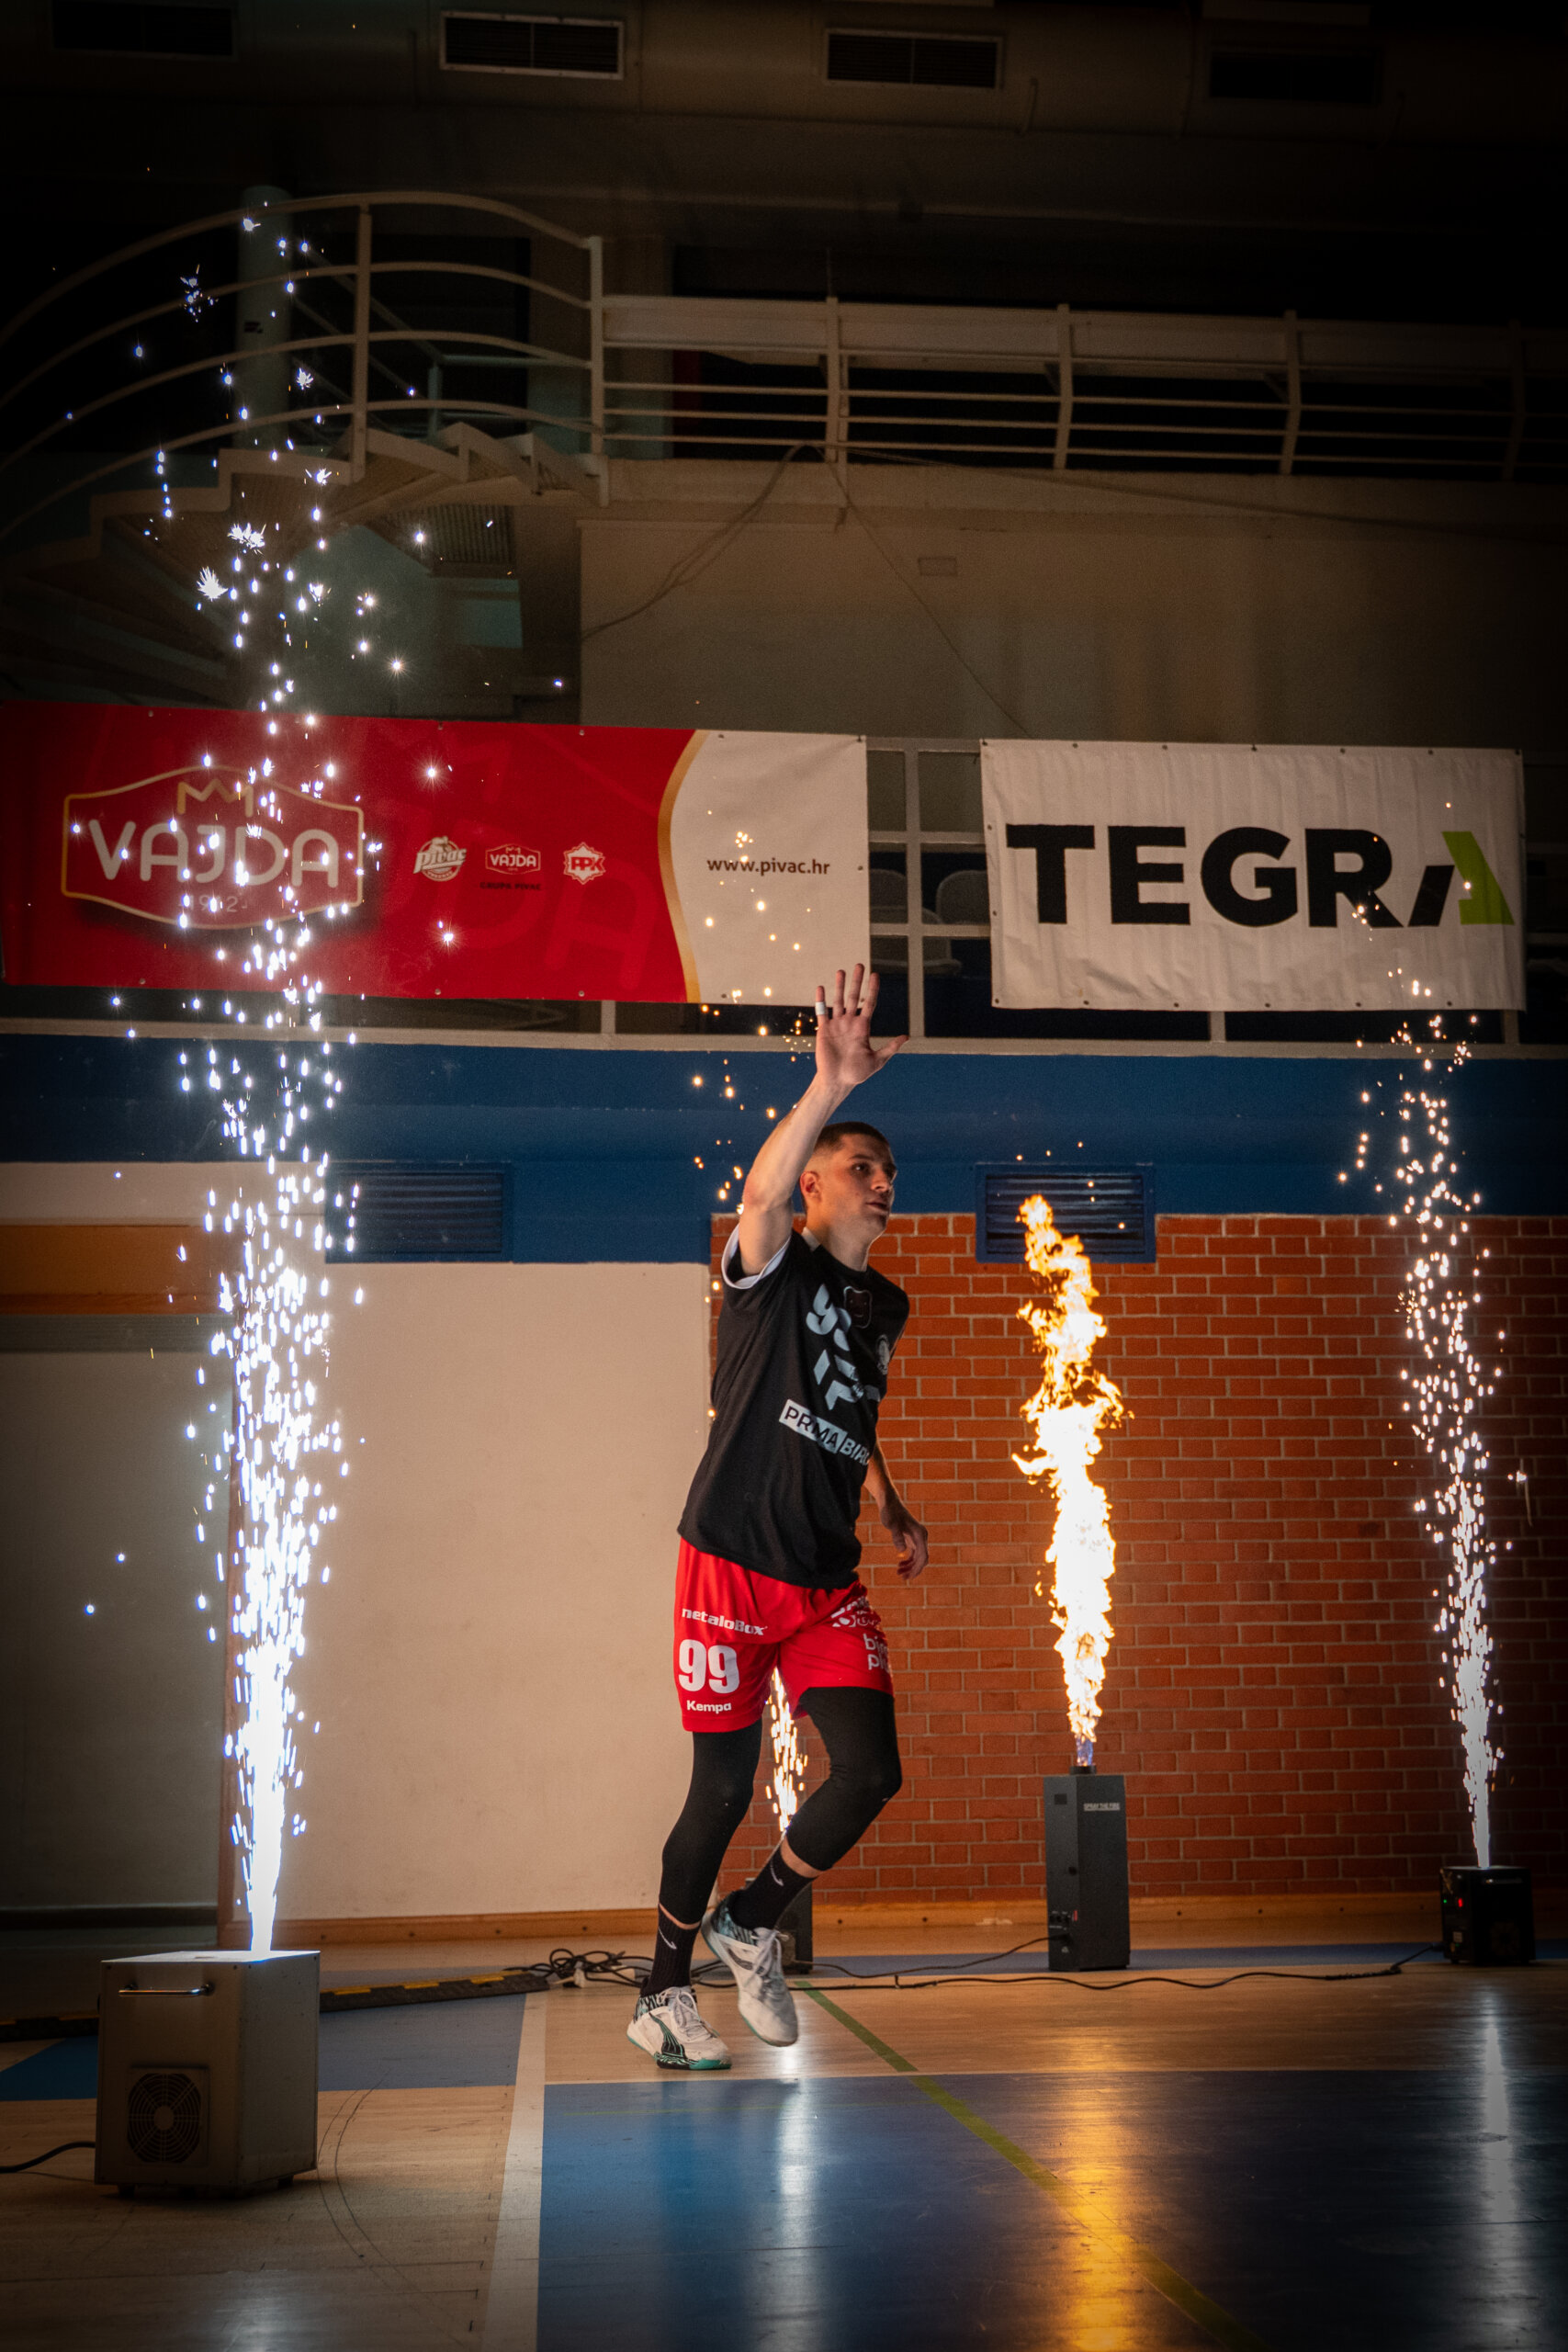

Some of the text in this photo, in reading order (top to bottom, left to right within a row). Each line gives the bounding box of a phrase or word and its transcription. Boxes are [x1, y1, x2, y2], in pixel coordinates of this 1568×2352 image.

[88, 820, 339, 888] VAJDA
[490, 854, 536, 867] VAJDA
[571, 856, 604, 871] PPK
[706, 857, 830, 876] www.pivac.hr
[1006, 823, 1516, 928] TEGRA
[678, 1638, 740, 1694] 99
[686, 1700, 732, 1714] Kempa
